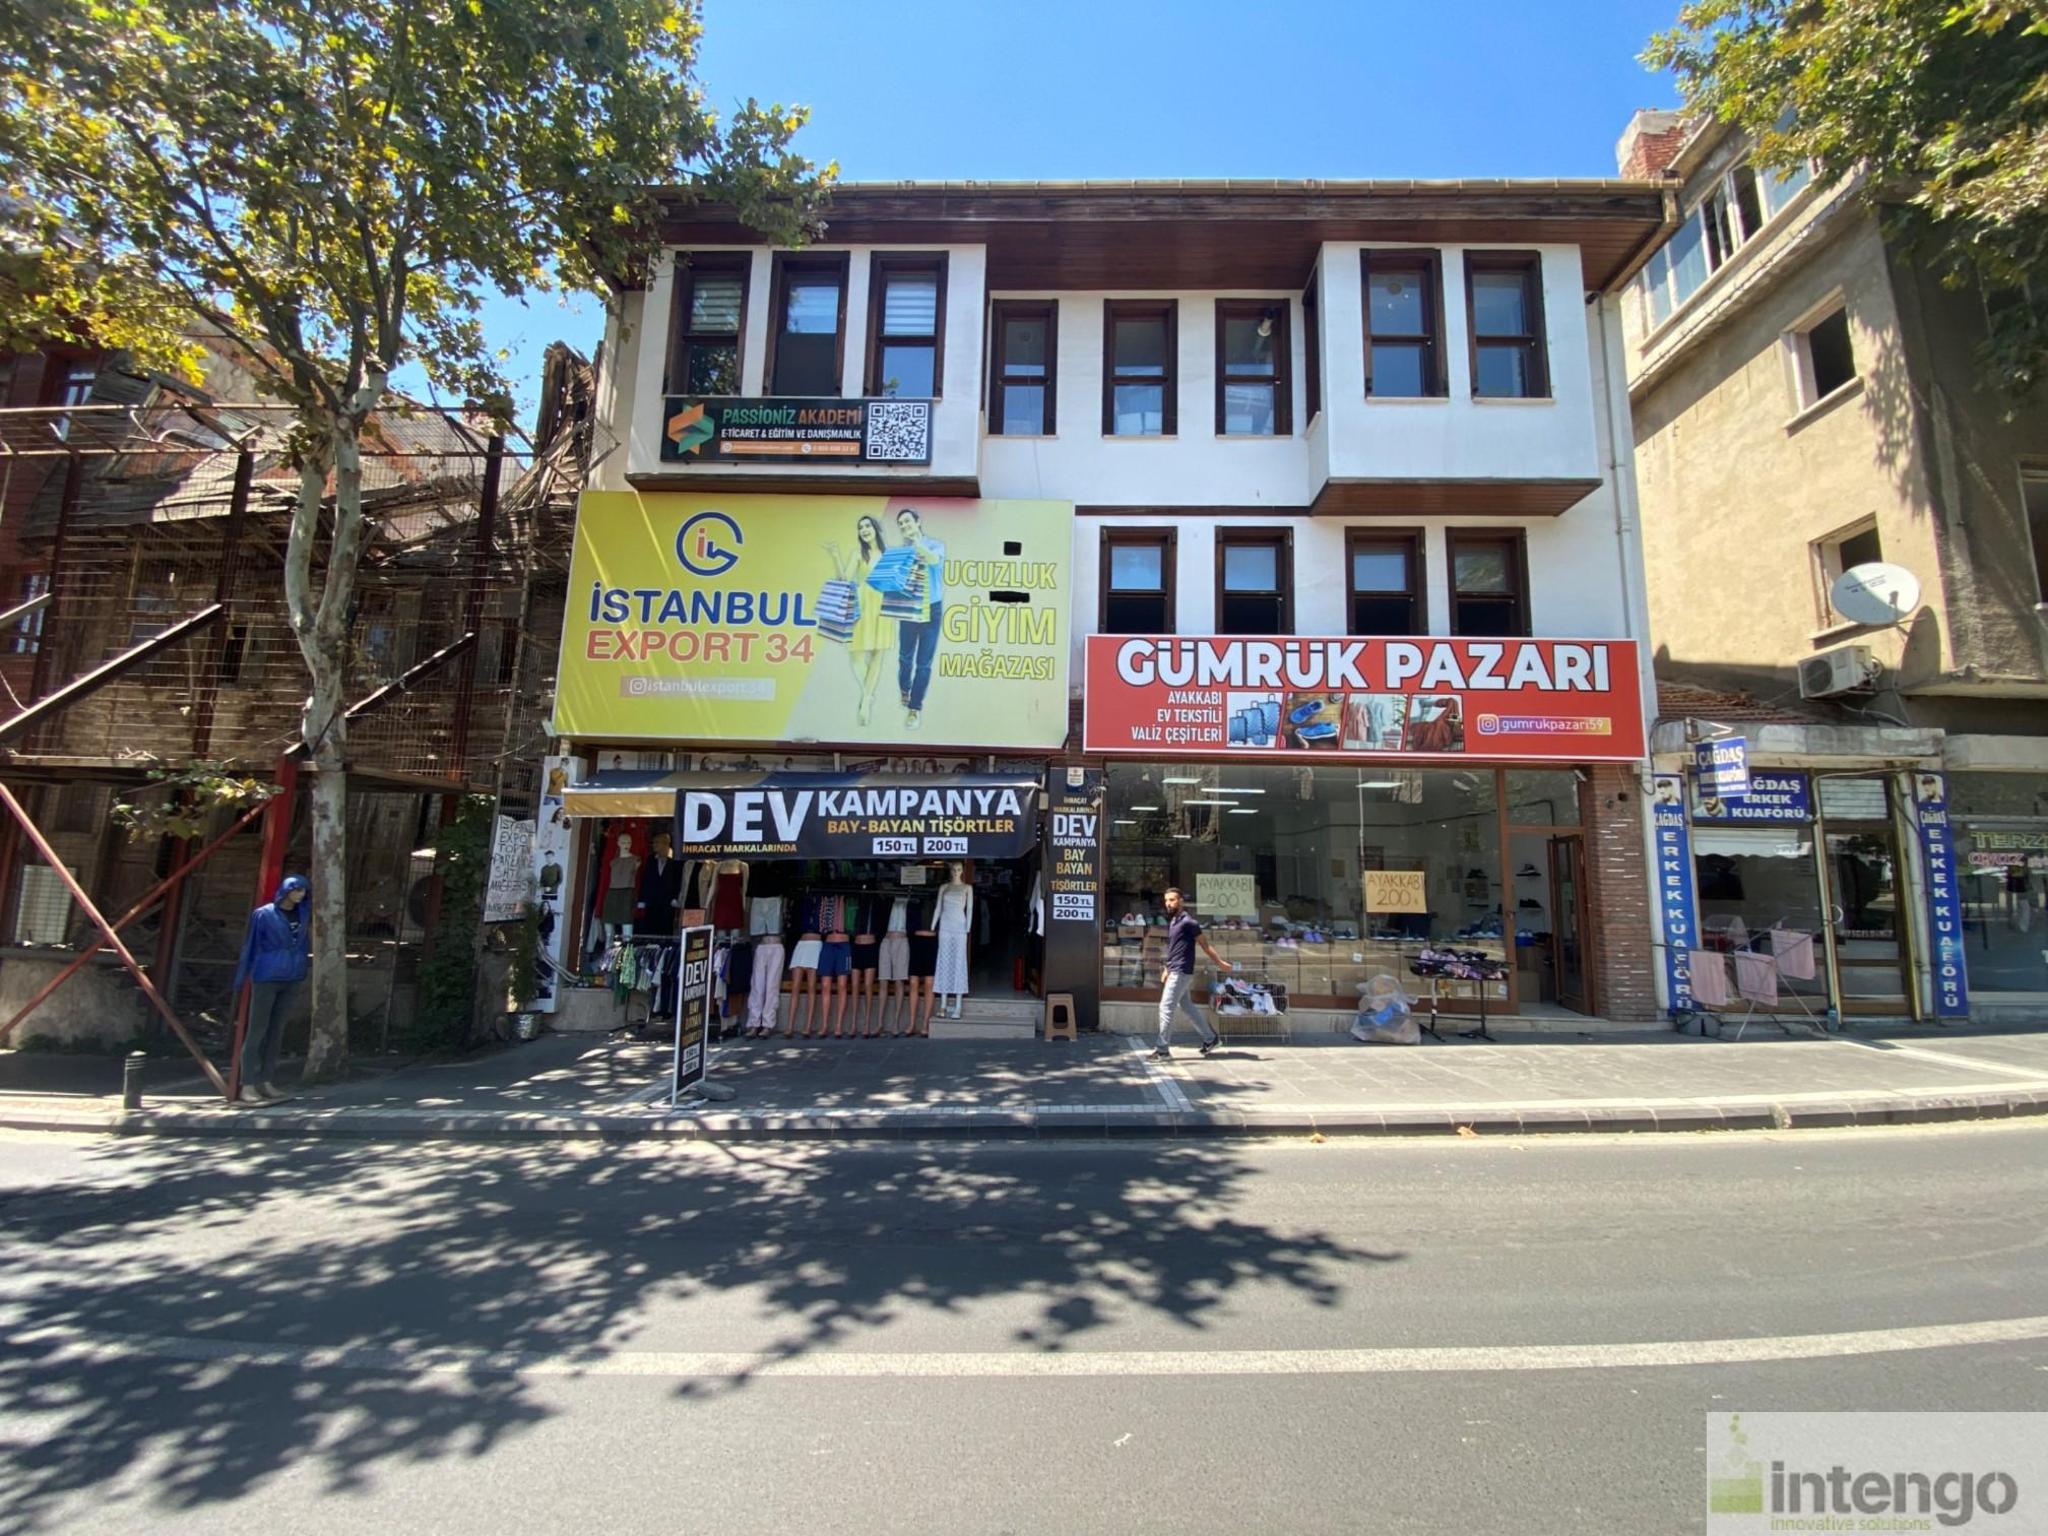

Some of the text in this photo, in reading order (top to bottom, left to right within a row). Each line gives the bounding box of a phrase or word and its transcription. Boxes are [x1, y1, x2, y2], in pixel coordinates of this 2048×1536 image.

[722, 405, 862, 425] PASSİONİZ AKADEMİ
[721, 427, 862, 440] E-TİCARET & EĞİTİM VE DANIŞMANLIK
[943, 560, 1057, 589] UCUZLUK
[590, 581, 818, 626] İSTANBUL
[942, 596, 1056, 645] GİYİM
[587, 629, 815, 664] EXPORT 34
[939, 649, 1055, 680] MAĞAZASI
[1116, 637, 1611, 692] GÜMRÜK PAZARI
[1167, 691, 1222, 705] AYAKKABI
[1157, 706, 1222, 724] EV TEKSTİLİ
[1131, 724, 1222, 744] VALİZ ÇEŞİTLERİ
[1501, 718, 1604, 734] gumrukpazari59
[1698, 744, 1744, 770] ÇAĞDAŞ
[1749, 777, 1801, 793] ĞDAŞ
[1743, 793, 1792, 804] ERKEK
[683, 788, 1022, 843] DEV KAMPANYA
[1732, 805, 1805, 818] KUAFÖRÜ
[827, 817, 1015, 837] BAY-BAYAN TİŞÖRTLER
[1053, 814, 1097, 837] DEV
[683, 843, 797, 853] İHRACAT MARKALARINDA
[876, 839, 966, 852] 150 TL 200 TL
[1053, 837, 1097, 847] KAMPANYA
[1064, 848, 1086, 861] BAY
[1929, 828, 1949, 898] ERKEK
[1056, 862, 1092, 875] BAYAN
[1663, 831, 1682, 901] ERKEK
[1051, 879, 1097, 892] TİŞÖRTLER
[1367, 873, 1424, 890] AYAKKABI
[1056, 896, 1078, 905] 150
[1376, 888, 1411, 906] 200
[1056, 909, 1078, 918] 200
[1668, 908, 1693, 1010] KUAFÖRÜ
[1936, 905, 1959, 1008] KUAFÖRÜ
[686, 959, 708, 986] DEV
